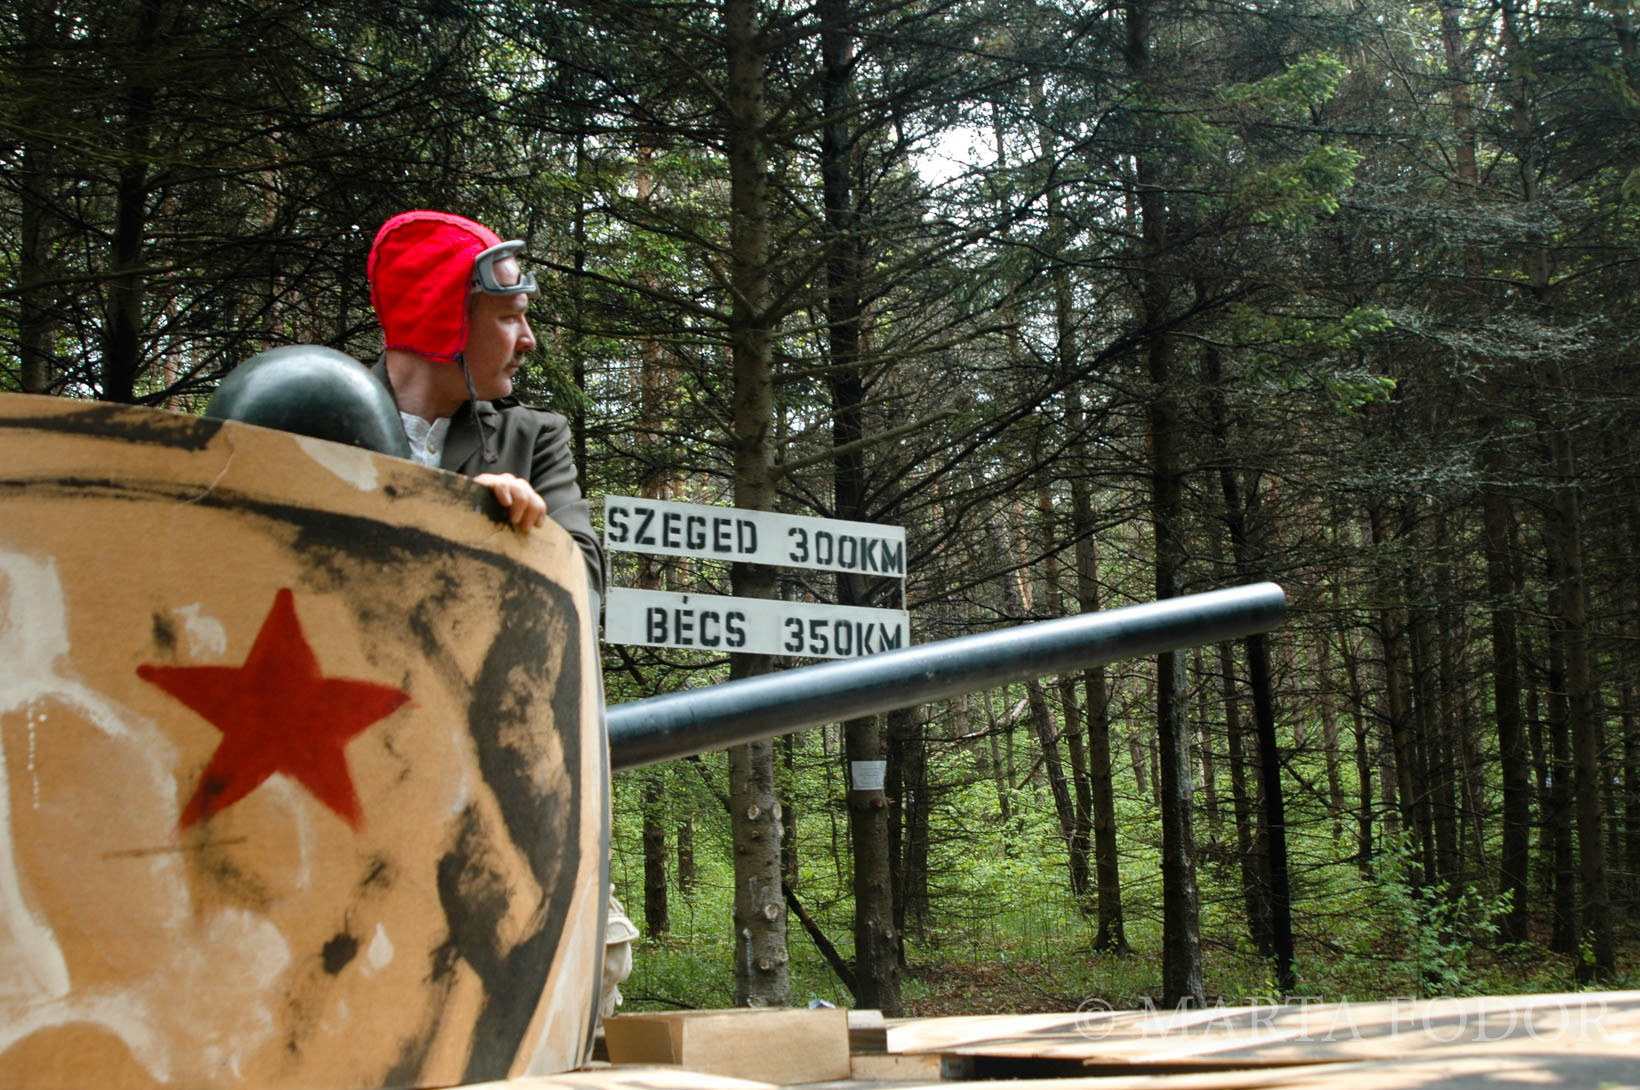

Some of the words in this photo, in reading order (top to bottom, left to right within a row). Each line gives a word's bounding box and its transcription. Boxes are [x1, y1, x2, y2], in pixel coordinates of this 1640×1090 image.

[608, 506, 758, 554] SZEGED
[788, 525, 904, 575] 300KM
[646, 595, 746, 648] BÉCS
[784, 617, 902, 657] 350KM
